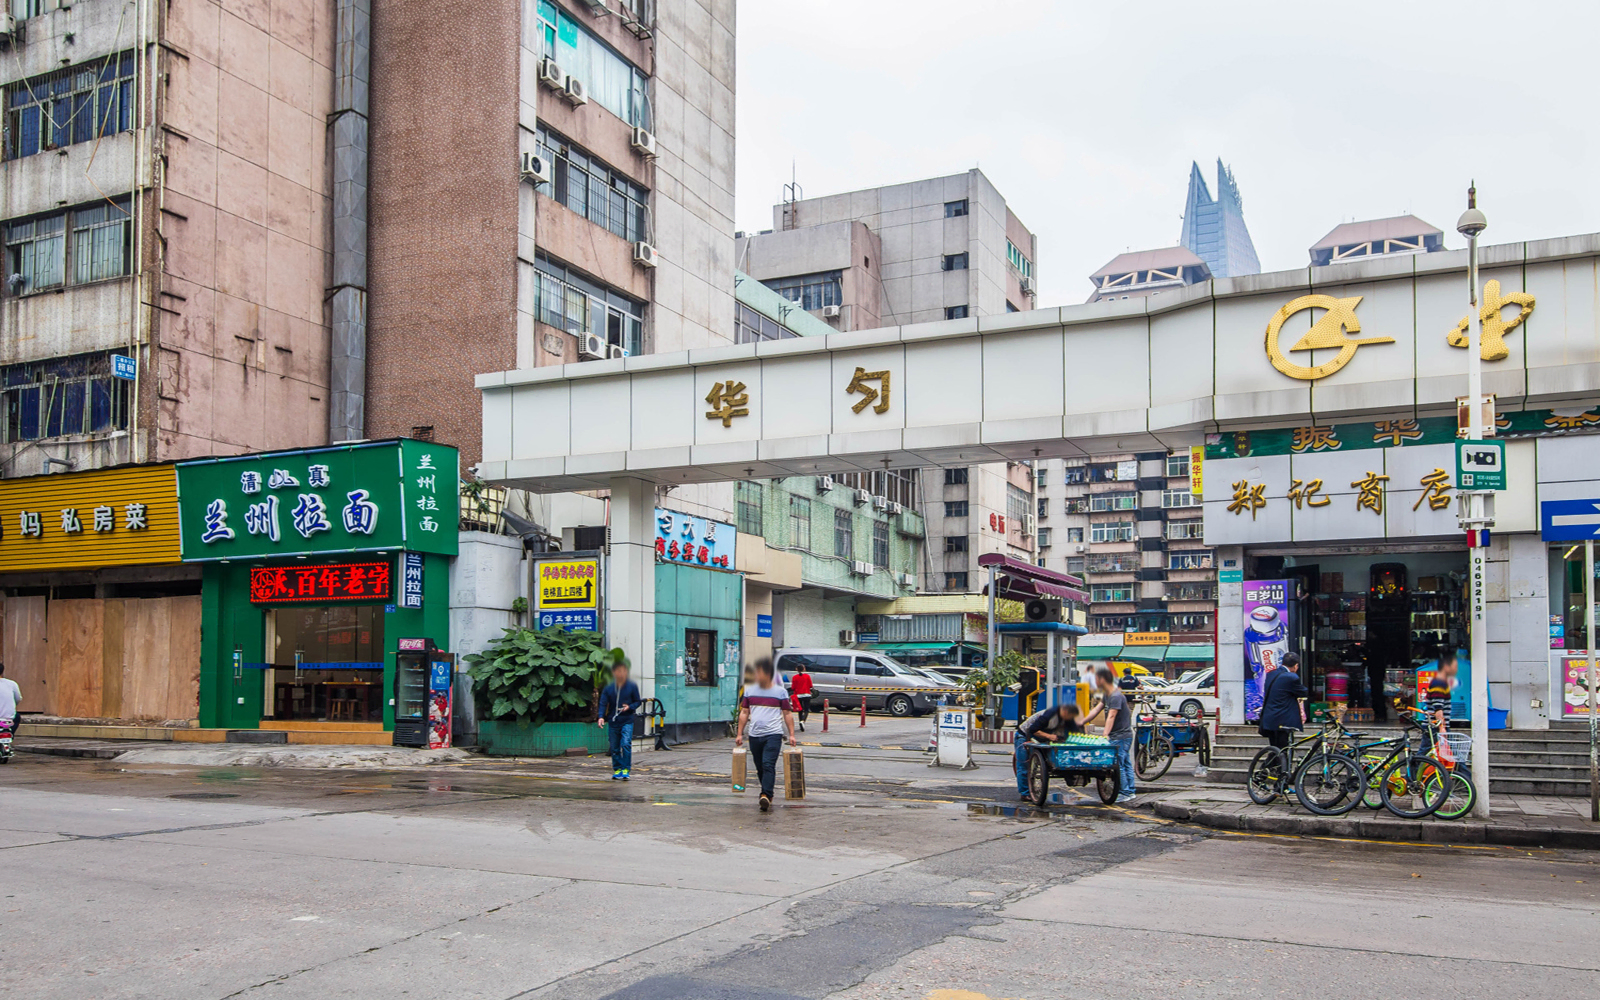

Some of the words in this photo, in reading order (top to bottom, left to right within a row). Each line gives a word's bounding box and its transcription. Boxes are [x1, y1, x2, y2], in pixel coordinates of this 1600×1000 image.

[416, 453, 440, 533] 兰州拉面
[1192, 452, 1202, 488] 振华轩
[1226, 467, 1453, 522] 郑记商店
[201, 489, 379, 544] 兰州拉面
[406, 553, 422, 606] 兰州拉面
[1246, 590, 1284, 601] 百岁山
[1474, 557, 1482, 620] 04692191
[943, 712, 963, 724] 进口
